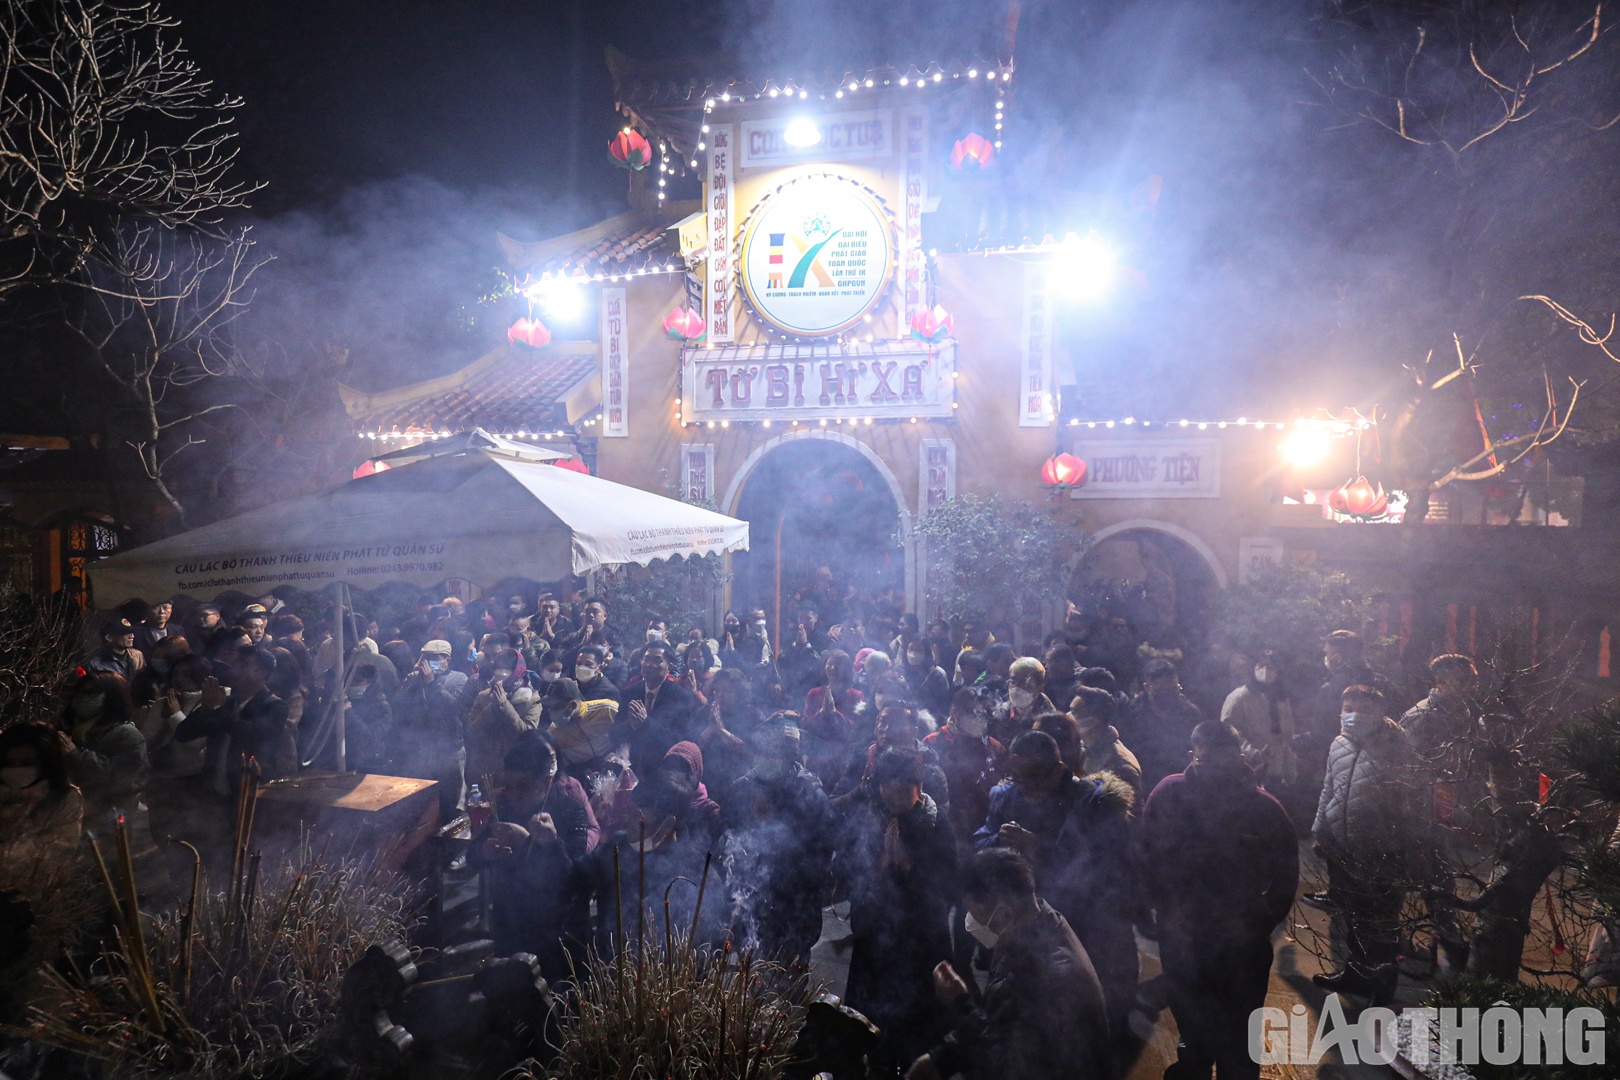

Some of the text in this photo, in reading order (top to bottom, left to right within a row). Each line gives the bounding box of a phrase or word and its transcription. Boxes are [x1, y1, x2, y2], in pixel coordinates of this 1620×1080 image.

[837, 279, 866, 288] GHPGVN
[610, 337, 620, 353] BI
[766, 364, 805, 402] BI
[1162, 452, 1201, 485] TIỆN
[221, 558, 238, 572] BỘ
[239, 555, 277, 568] THANH
[392, 542, 427, 558] QUÁN
